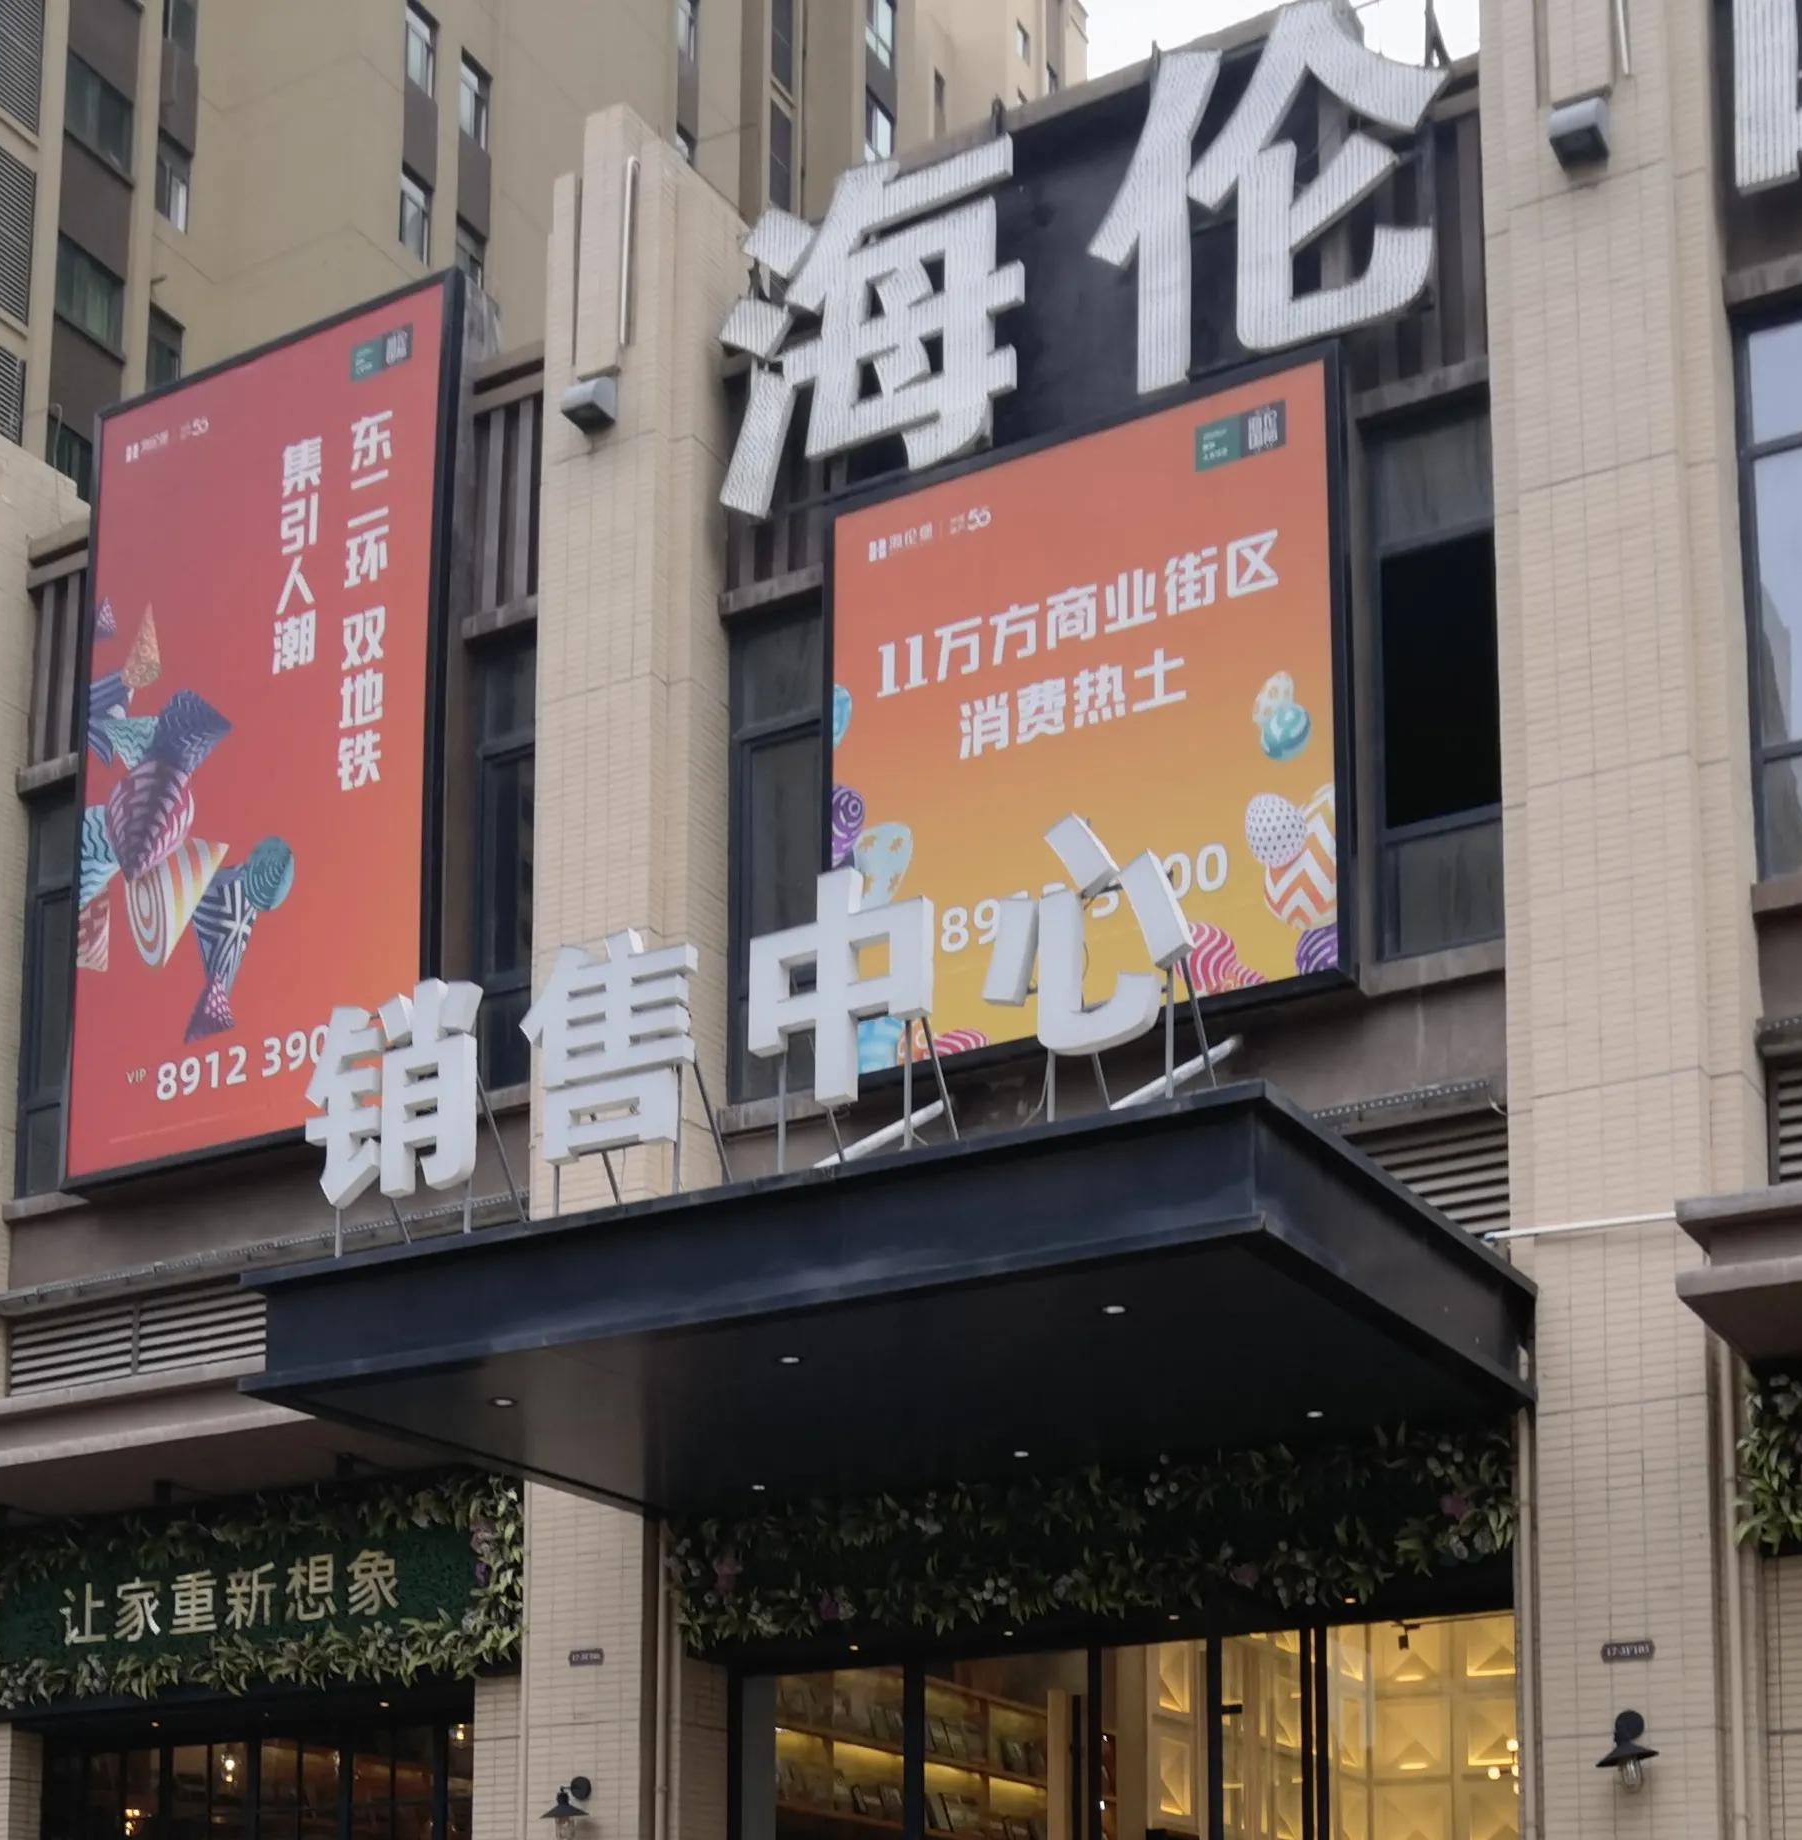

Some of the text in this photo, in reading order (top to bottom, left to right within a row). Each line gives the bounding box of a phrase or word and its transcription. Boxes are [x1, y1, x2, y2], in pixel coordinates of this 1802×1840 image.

[718, 1, 1449, 519] 海伦
[272, 435, 322, 676] 集引人潮
[337, 410, 394, 791] 东二环 双地铁
[877, 529, 1278, 699] 11万方商业街区
[959, 649, 1187, 760] 消费热土
[126, 1024, 329, 1101] VIP 8912 390
[305, 812, 1197, 1209] 销售中心
[60, 1550, 399, 1646] 让家重新想象
